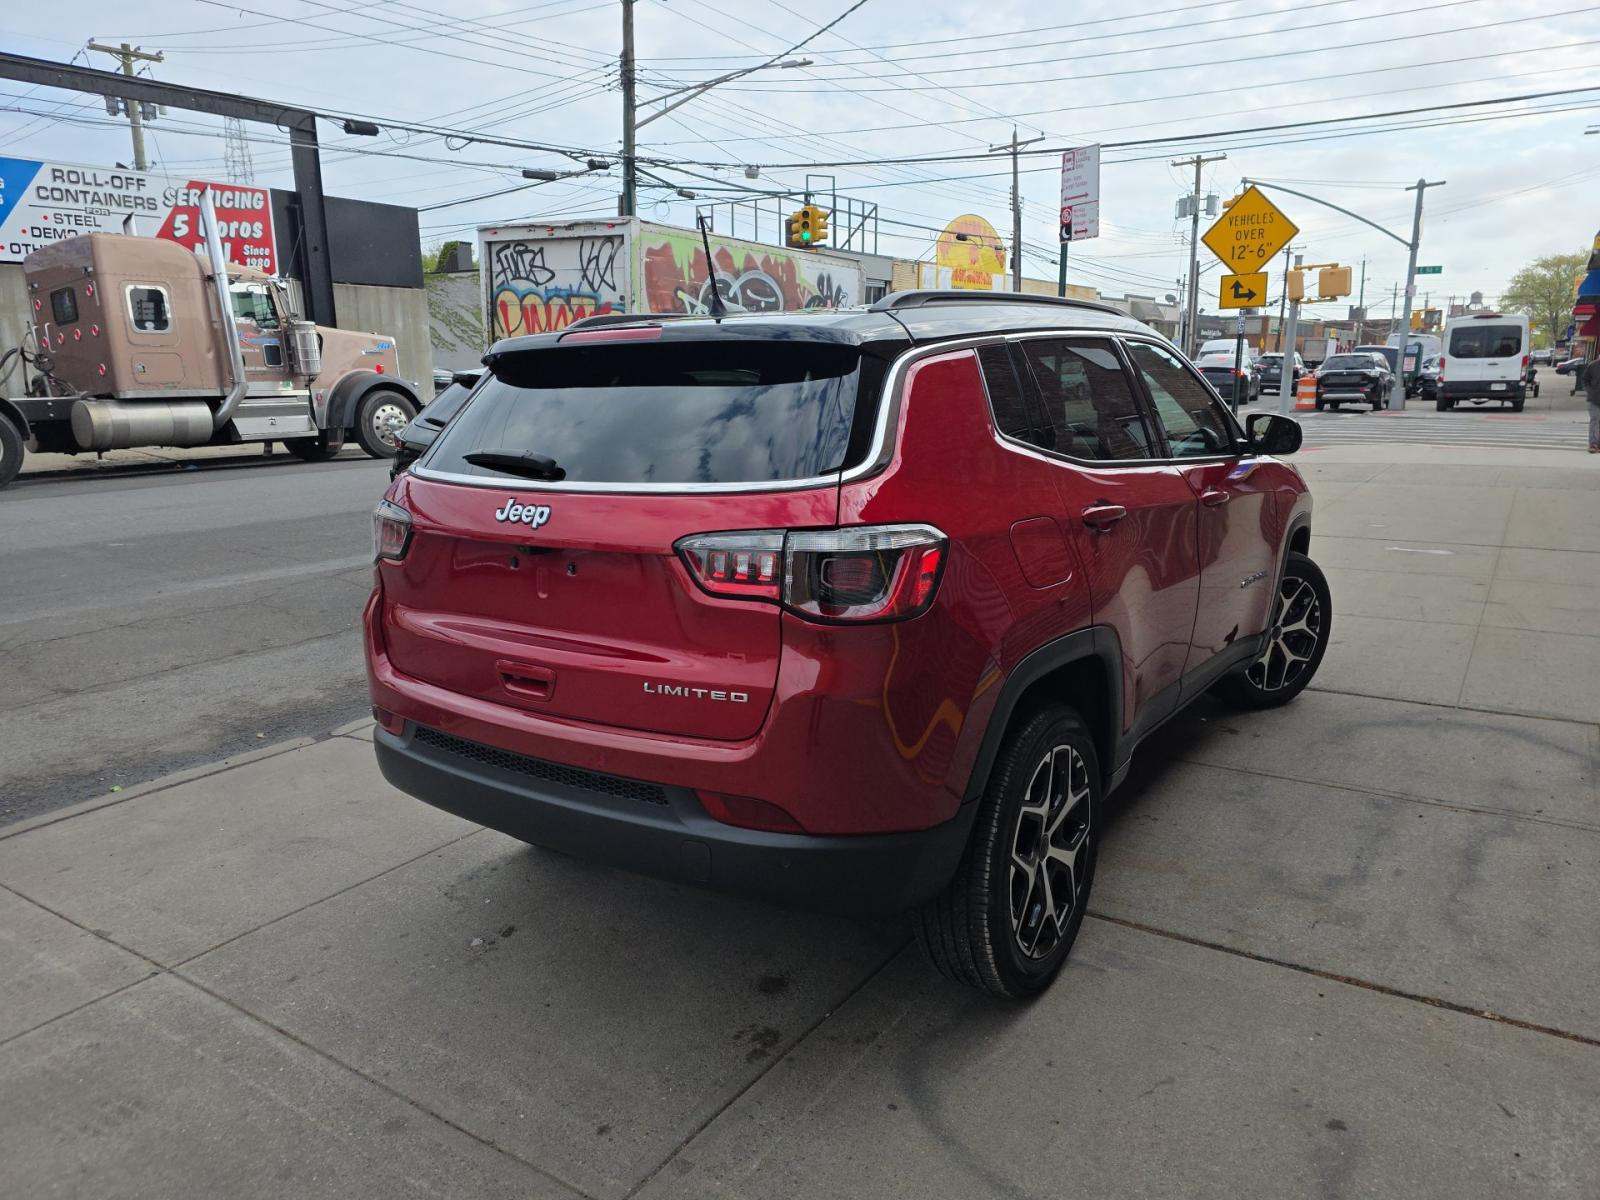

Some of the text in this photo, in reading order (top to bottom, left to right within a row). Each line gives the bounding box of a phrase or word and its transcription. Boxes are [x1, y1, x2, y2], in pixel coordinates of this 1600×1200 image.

[51, 168, 147, 191] ROLL-OFF
[36, 185, 159, 211] CONTAINERS
[87, 207, 110, 216] FOR
[1228, 211, 1274, 228] VEHICLES
[53, 213, 102, 228] STEEL
[173, 214, 190, 238] 5
[1235, 228, 1265, 241] OVER
[243, 244, 271, 256] Since
[246, 257, 271, 269] 1980
[494, 498, 552, 530] Jeep
[643, 682, 749, 703] LIMITED
